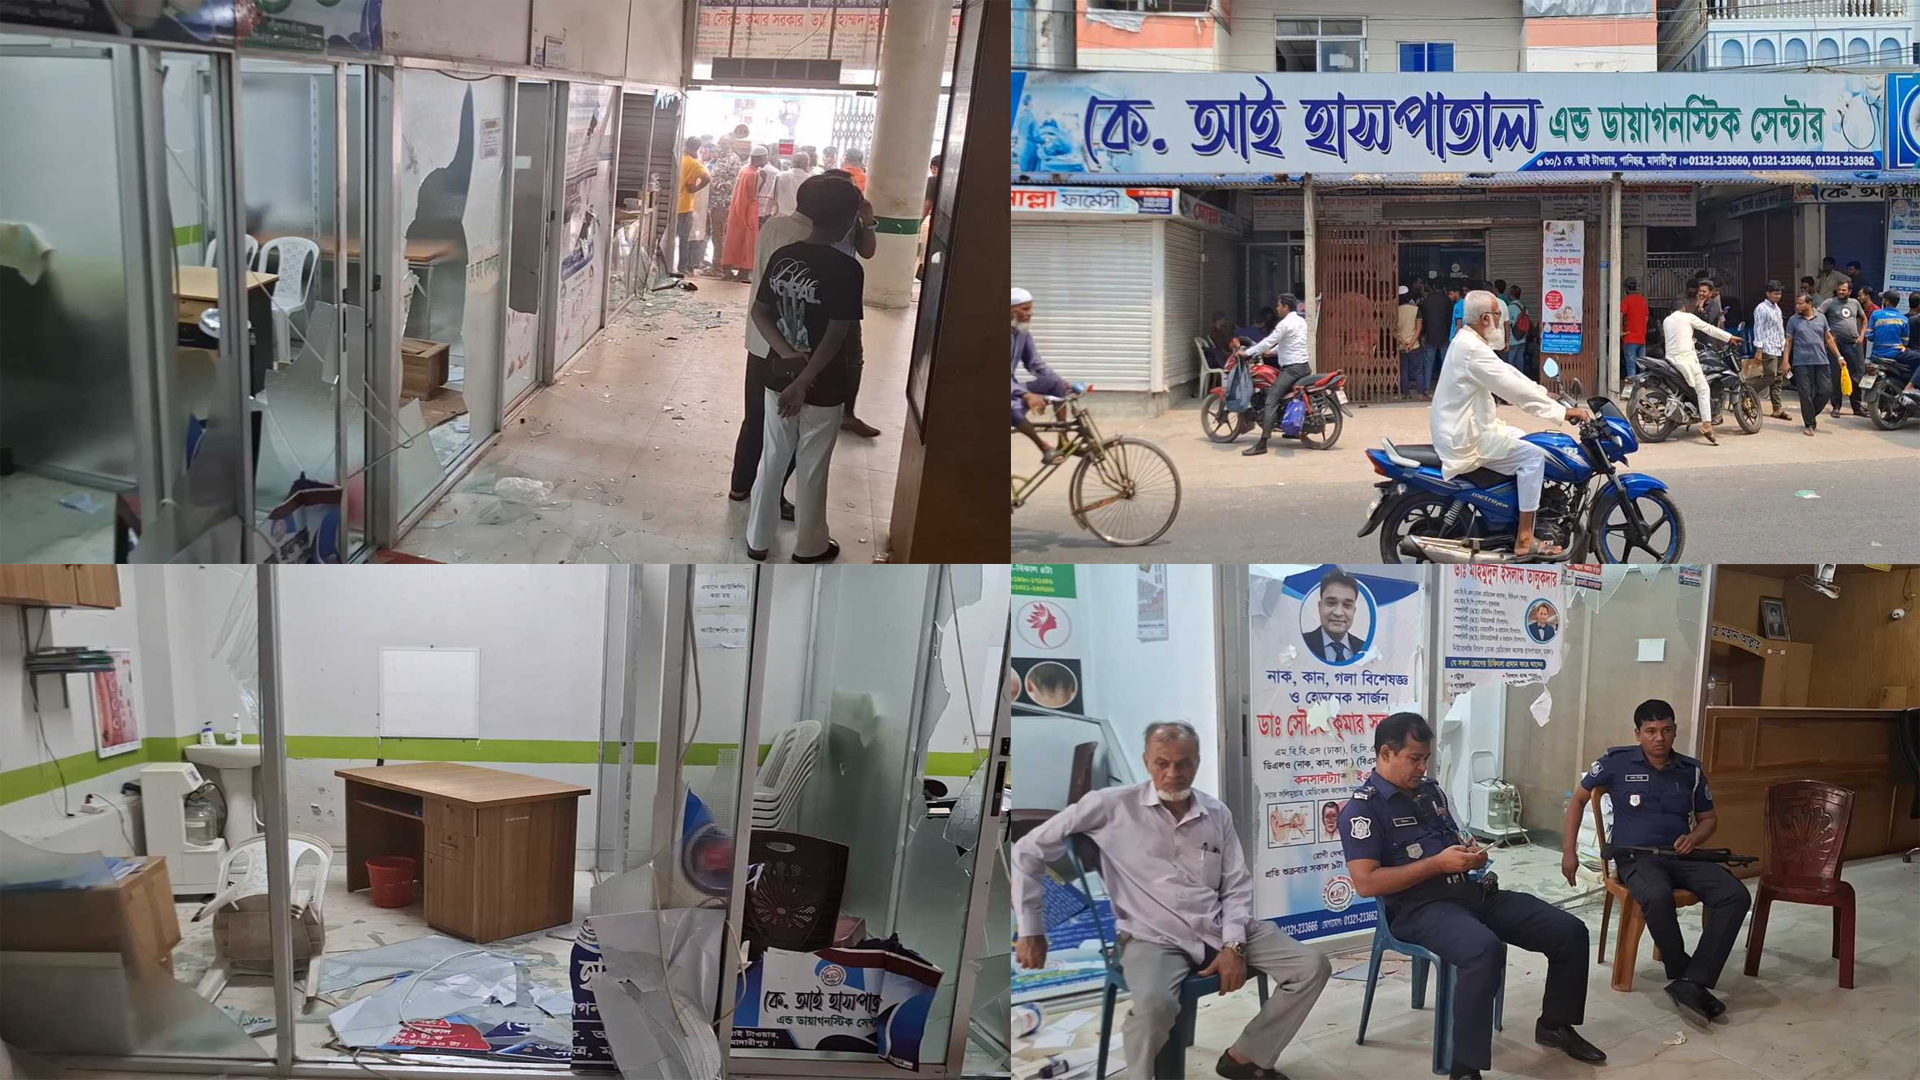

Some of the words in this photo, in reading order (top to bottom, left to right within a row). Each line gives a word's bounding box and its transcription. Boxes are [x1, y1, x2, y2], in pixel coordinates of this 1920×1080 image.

[713, 9, 742, 26] সৌরভ
[745, 13, 769, 30] কুমার
[772, 13, 804, 28] সরকার
[811, 13, 826, 27] ডাঃ
[1084, 96, 1169, 165] কে.
[1187, 76, 1287, 163] আই
[1300, 91, 1544, 164] হাসপাতাল
[1549, 106, 1592, 144] এন্ড
[1599, 94, 1744, 145] ডায়াগনস্টিক
[1751, 94, 1827, 144] সেন্টার
[1563, 156, 1575, 167] কে.
[1577, 154, 1591, 168] আই
[1592, 153, 1618, 168] টাওয়ার,
[1647, 153, 1677, 168] মাদারীপুর
[1689, 156, 1752, 168] 01321-233660,
[1752, 156, 1814, 168] 01321-233666,
[1816, 156, 1875, 167] 01321-233662
[1060, 189, 1121, 209] ফার্মেসী
[1266, 670, 1297, 687] নাক,
[1301, 670, 1329, 688] কান,
[1335, 672, 1357, 685] গলা
[1362, 670, 1409, 687] বিশেষজ্ঞ
[1289, 692, 1300, 703] ও
[1357, 689, 1390, 706] সার্জন
[1256, 710, 1281, 737] ডাঃ
[1332, 712, 1365, 742] কুমার
[1263, 759, 1291, 771] ডিএলও
[1293, 760, 1314, 771] (নাক,
[1316, 758, 1333, 769] কান,
[1335, 758, 1348, 767] গলা
[1313, 850, 1329, 860] রোগী
[1265, 867, 1280, 878] প্রতি
[1282, 865, 1308, 876] শুক্রবার
[1310, 862, 1330, 872] সকাল
[763, 990, 789, 1013] কে.
[794, 985, 824, 1012] আই
[776, 1015, 794, 1025] এন্ড
[795, 1013, 854, 1028] ডায়াগনস্টিক
